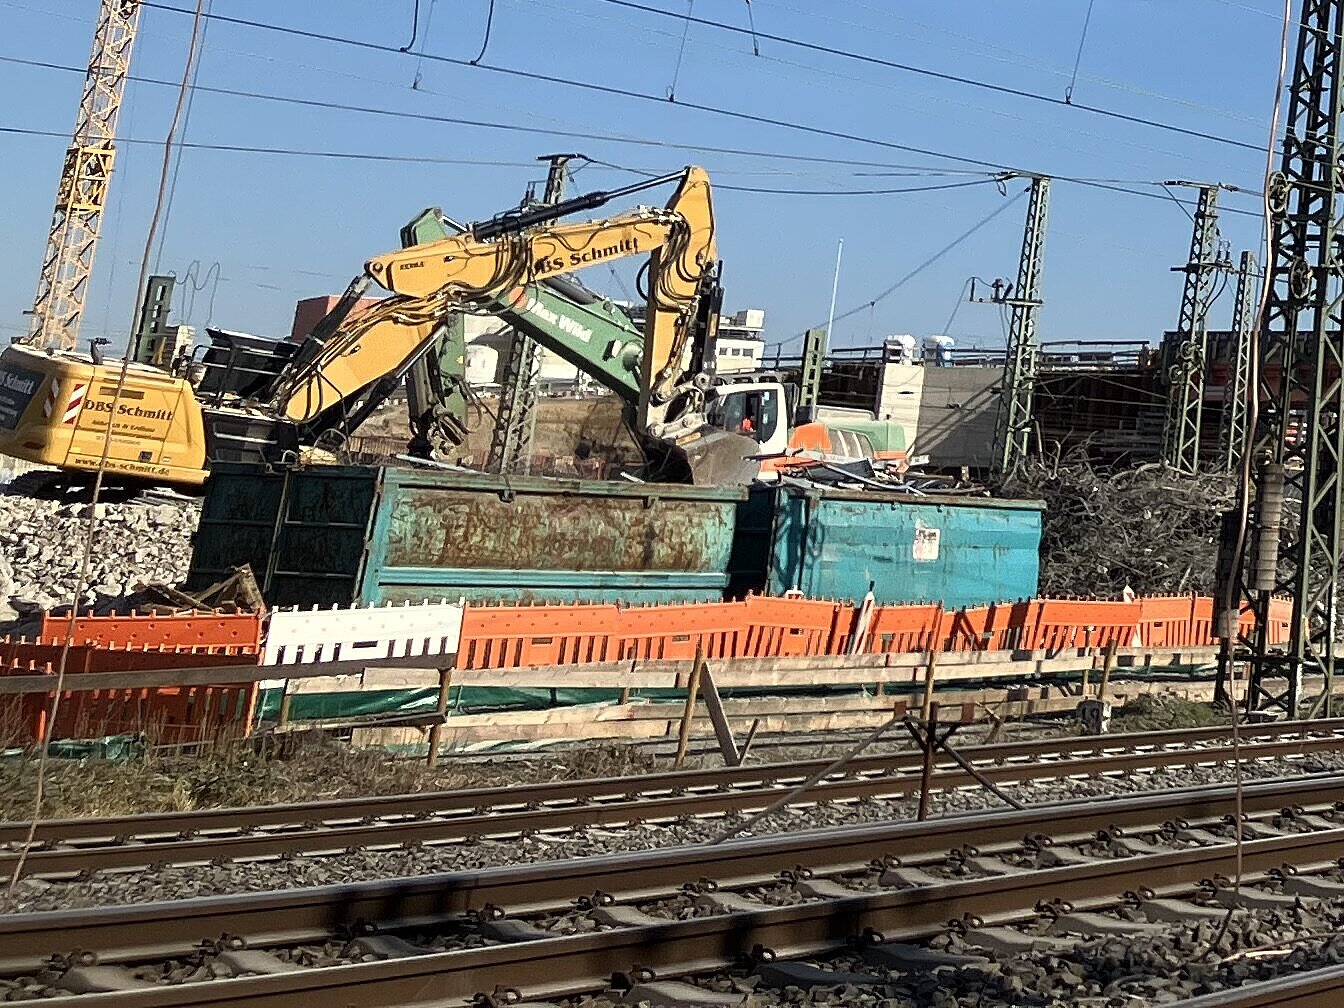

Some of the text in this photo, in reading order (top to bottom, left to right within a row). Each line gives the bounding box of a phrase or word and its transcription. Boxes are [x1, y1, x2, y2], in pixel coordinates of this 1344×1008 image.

[569, 237, 640, 268] Schmitt
[83, 398, 174, 421] DBS Schmitt
